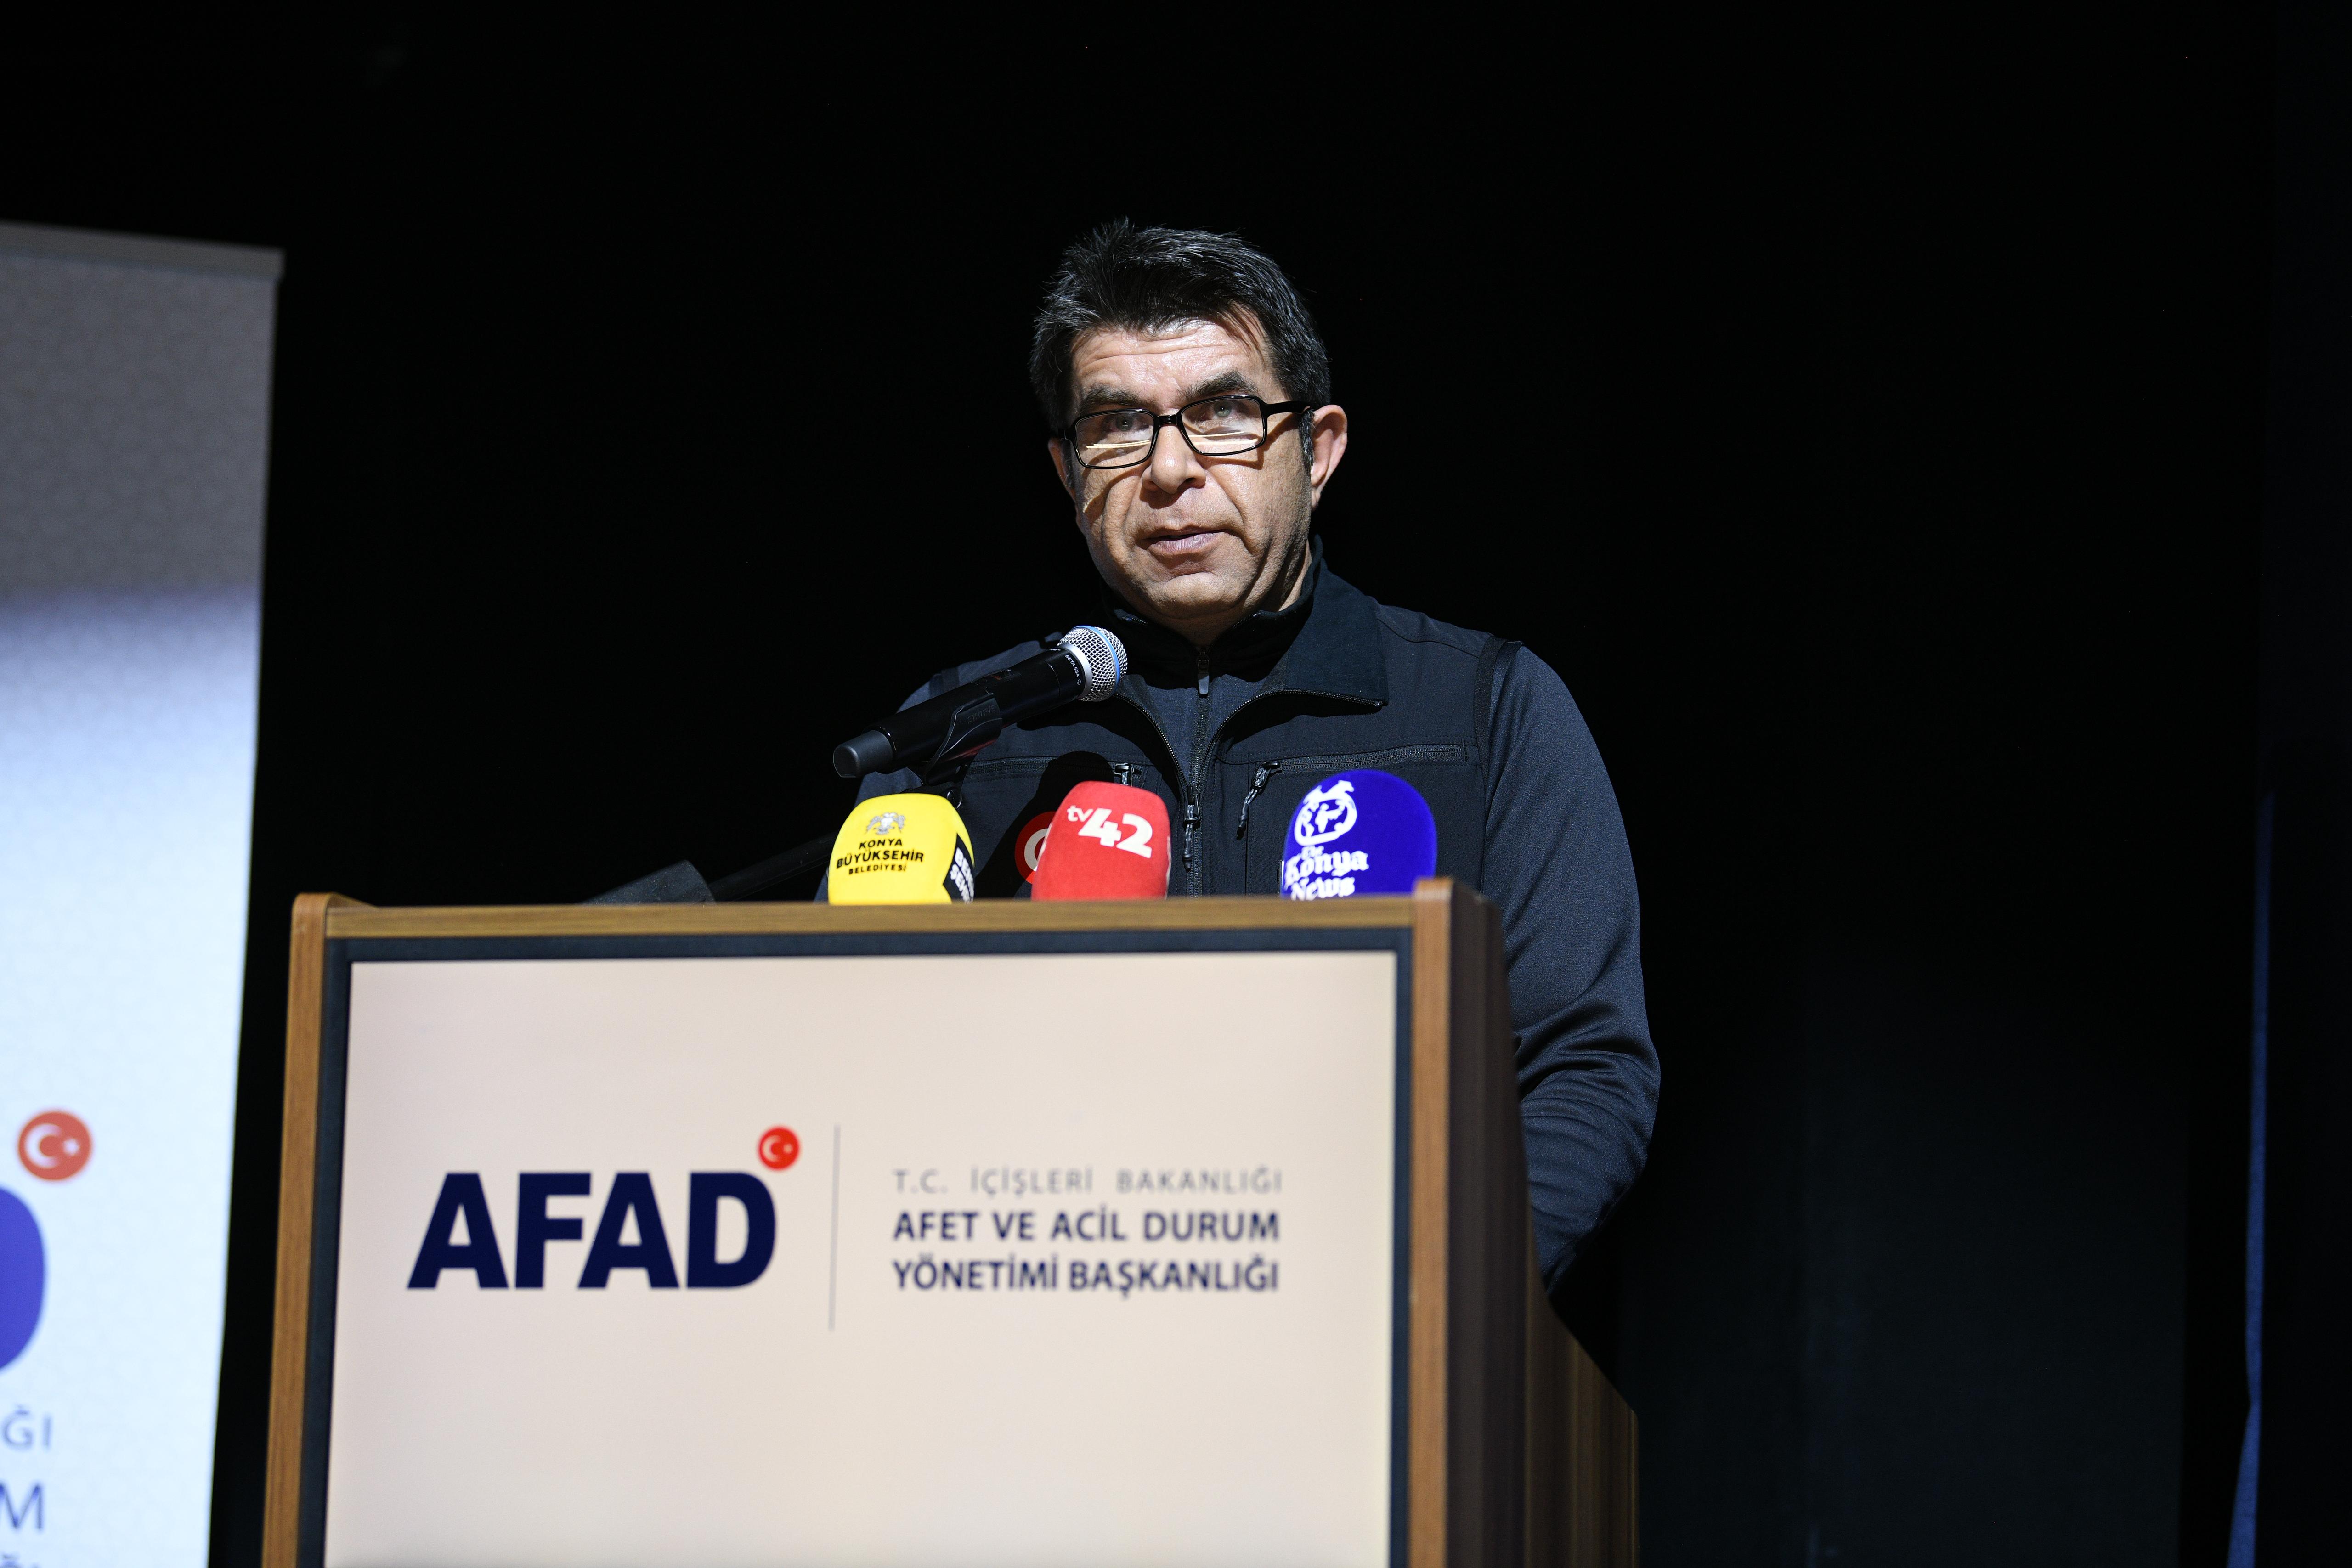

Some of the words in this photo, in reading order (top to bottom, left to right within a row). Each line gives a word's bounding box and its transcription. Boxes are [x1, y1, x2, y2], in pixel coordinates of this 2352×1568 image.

[1065, 654, 1075, 667] BETA
[859, 839, 903, 849] KONYA
[849, 863, 907, 875] BELEDİYESİ
[1284, 851, 1369, 891] Konya
[1291, 877, 1355, 901] News
[893, 1168, 948, 1195] T.C.
[970, 1165, 1094, 1199] İÇİŞLERİ
[1115, 1164, 1283, 1195] BAKANLIĞI
[406, 1172, 777, 1290] AFAD
[893, 1211, 979, 1241] AFET
[992, 1211, 1037, 1241] VE
[1050, 1202, 1128, 1241] ACİL
[1142, 1211, 1280, 1241] DURUM
[893, 1252, 1058, 1290] YÖNETİMİ
[1069, 1254, 1279, 1299] BAŞKANLIĞI
